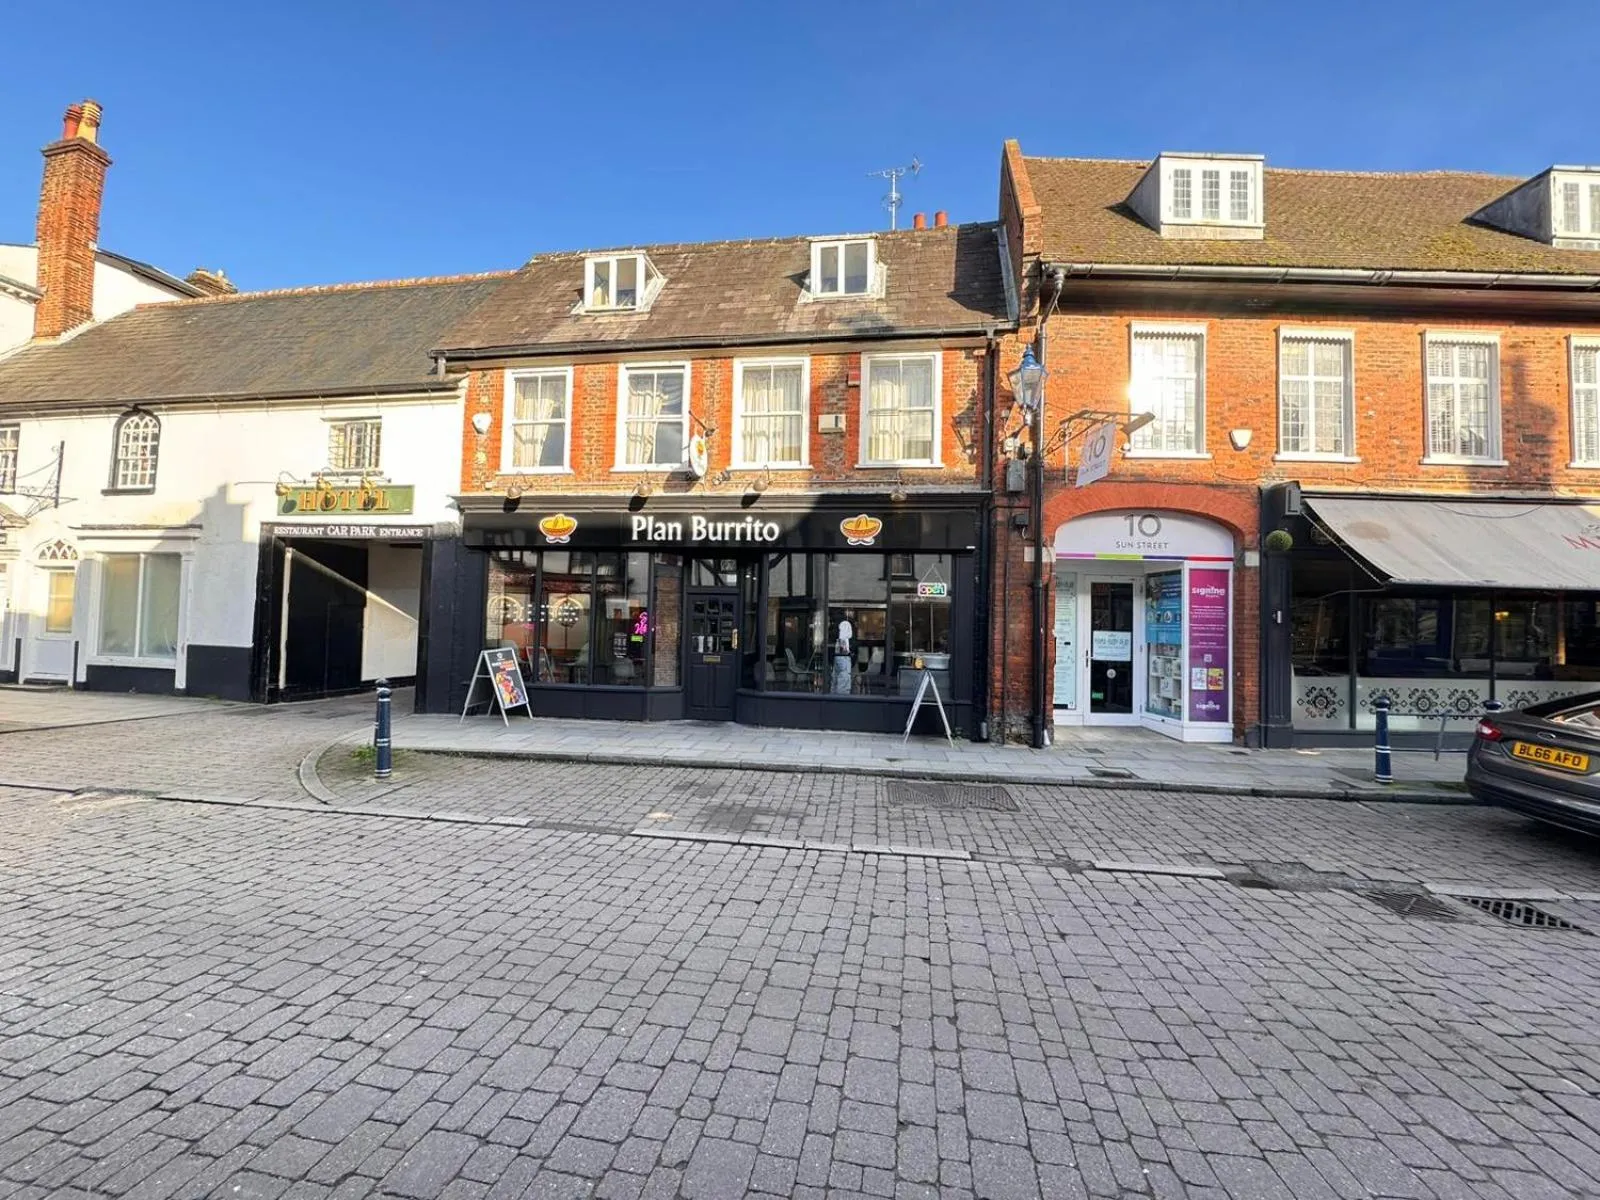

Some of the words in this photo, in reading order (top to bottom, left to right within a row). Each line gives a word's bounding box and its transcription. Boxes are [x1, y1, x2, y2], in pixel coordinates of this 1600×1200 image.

[1088, 434, 1106, 461] 10
[298, 489, 390, 512] HOTEL
[273, 526, 325, 536] RESTAURANT
[327, 525, 348, 537] CAR
[350, 526, 377, 537] PARK
[379, 527, 424, 537] ENTRANCE
[631, 515, 683, 541] Plan
[691, 515, 780, 542] Burrito
[1124, 513, 1162, 537] 10
[1115, 541, 1134, 549] SUN
[1136, 541, 1169, 549] STREET
[1519, 744, 1552, 760] BL66
[1554, 752, 1583, 766] AFO
